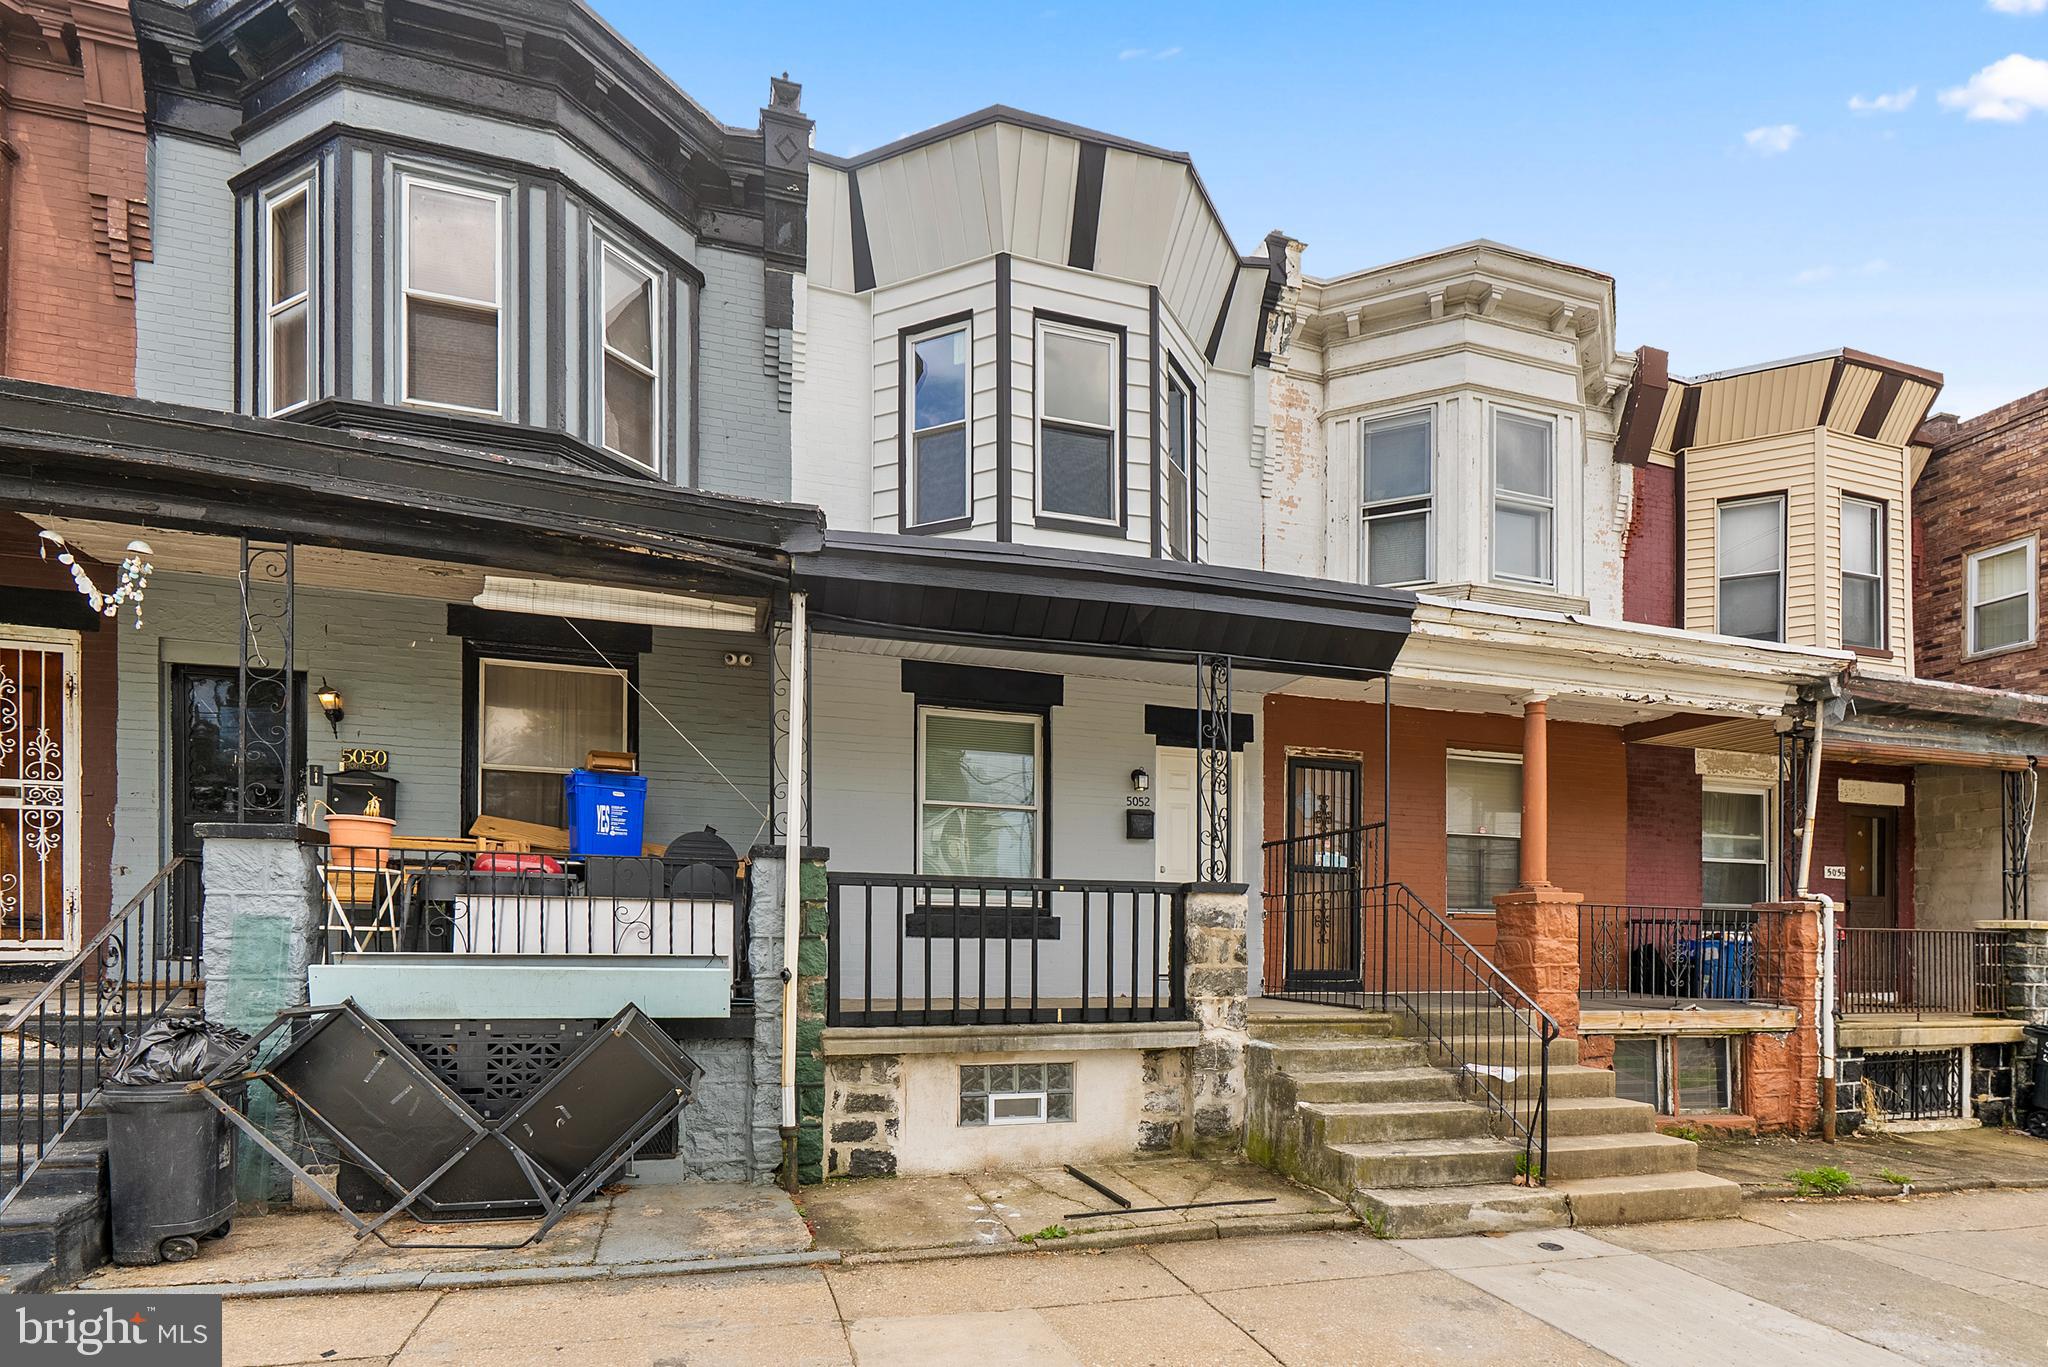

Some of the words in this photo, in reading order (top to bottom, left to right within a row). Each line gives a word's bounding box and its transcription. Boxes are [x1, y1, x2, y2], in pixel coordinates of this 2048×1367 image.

[342, 749, 387, 766] 5050
[1126, 796, 1150, 807] 5052
[596, 804, 610, 833] YES
